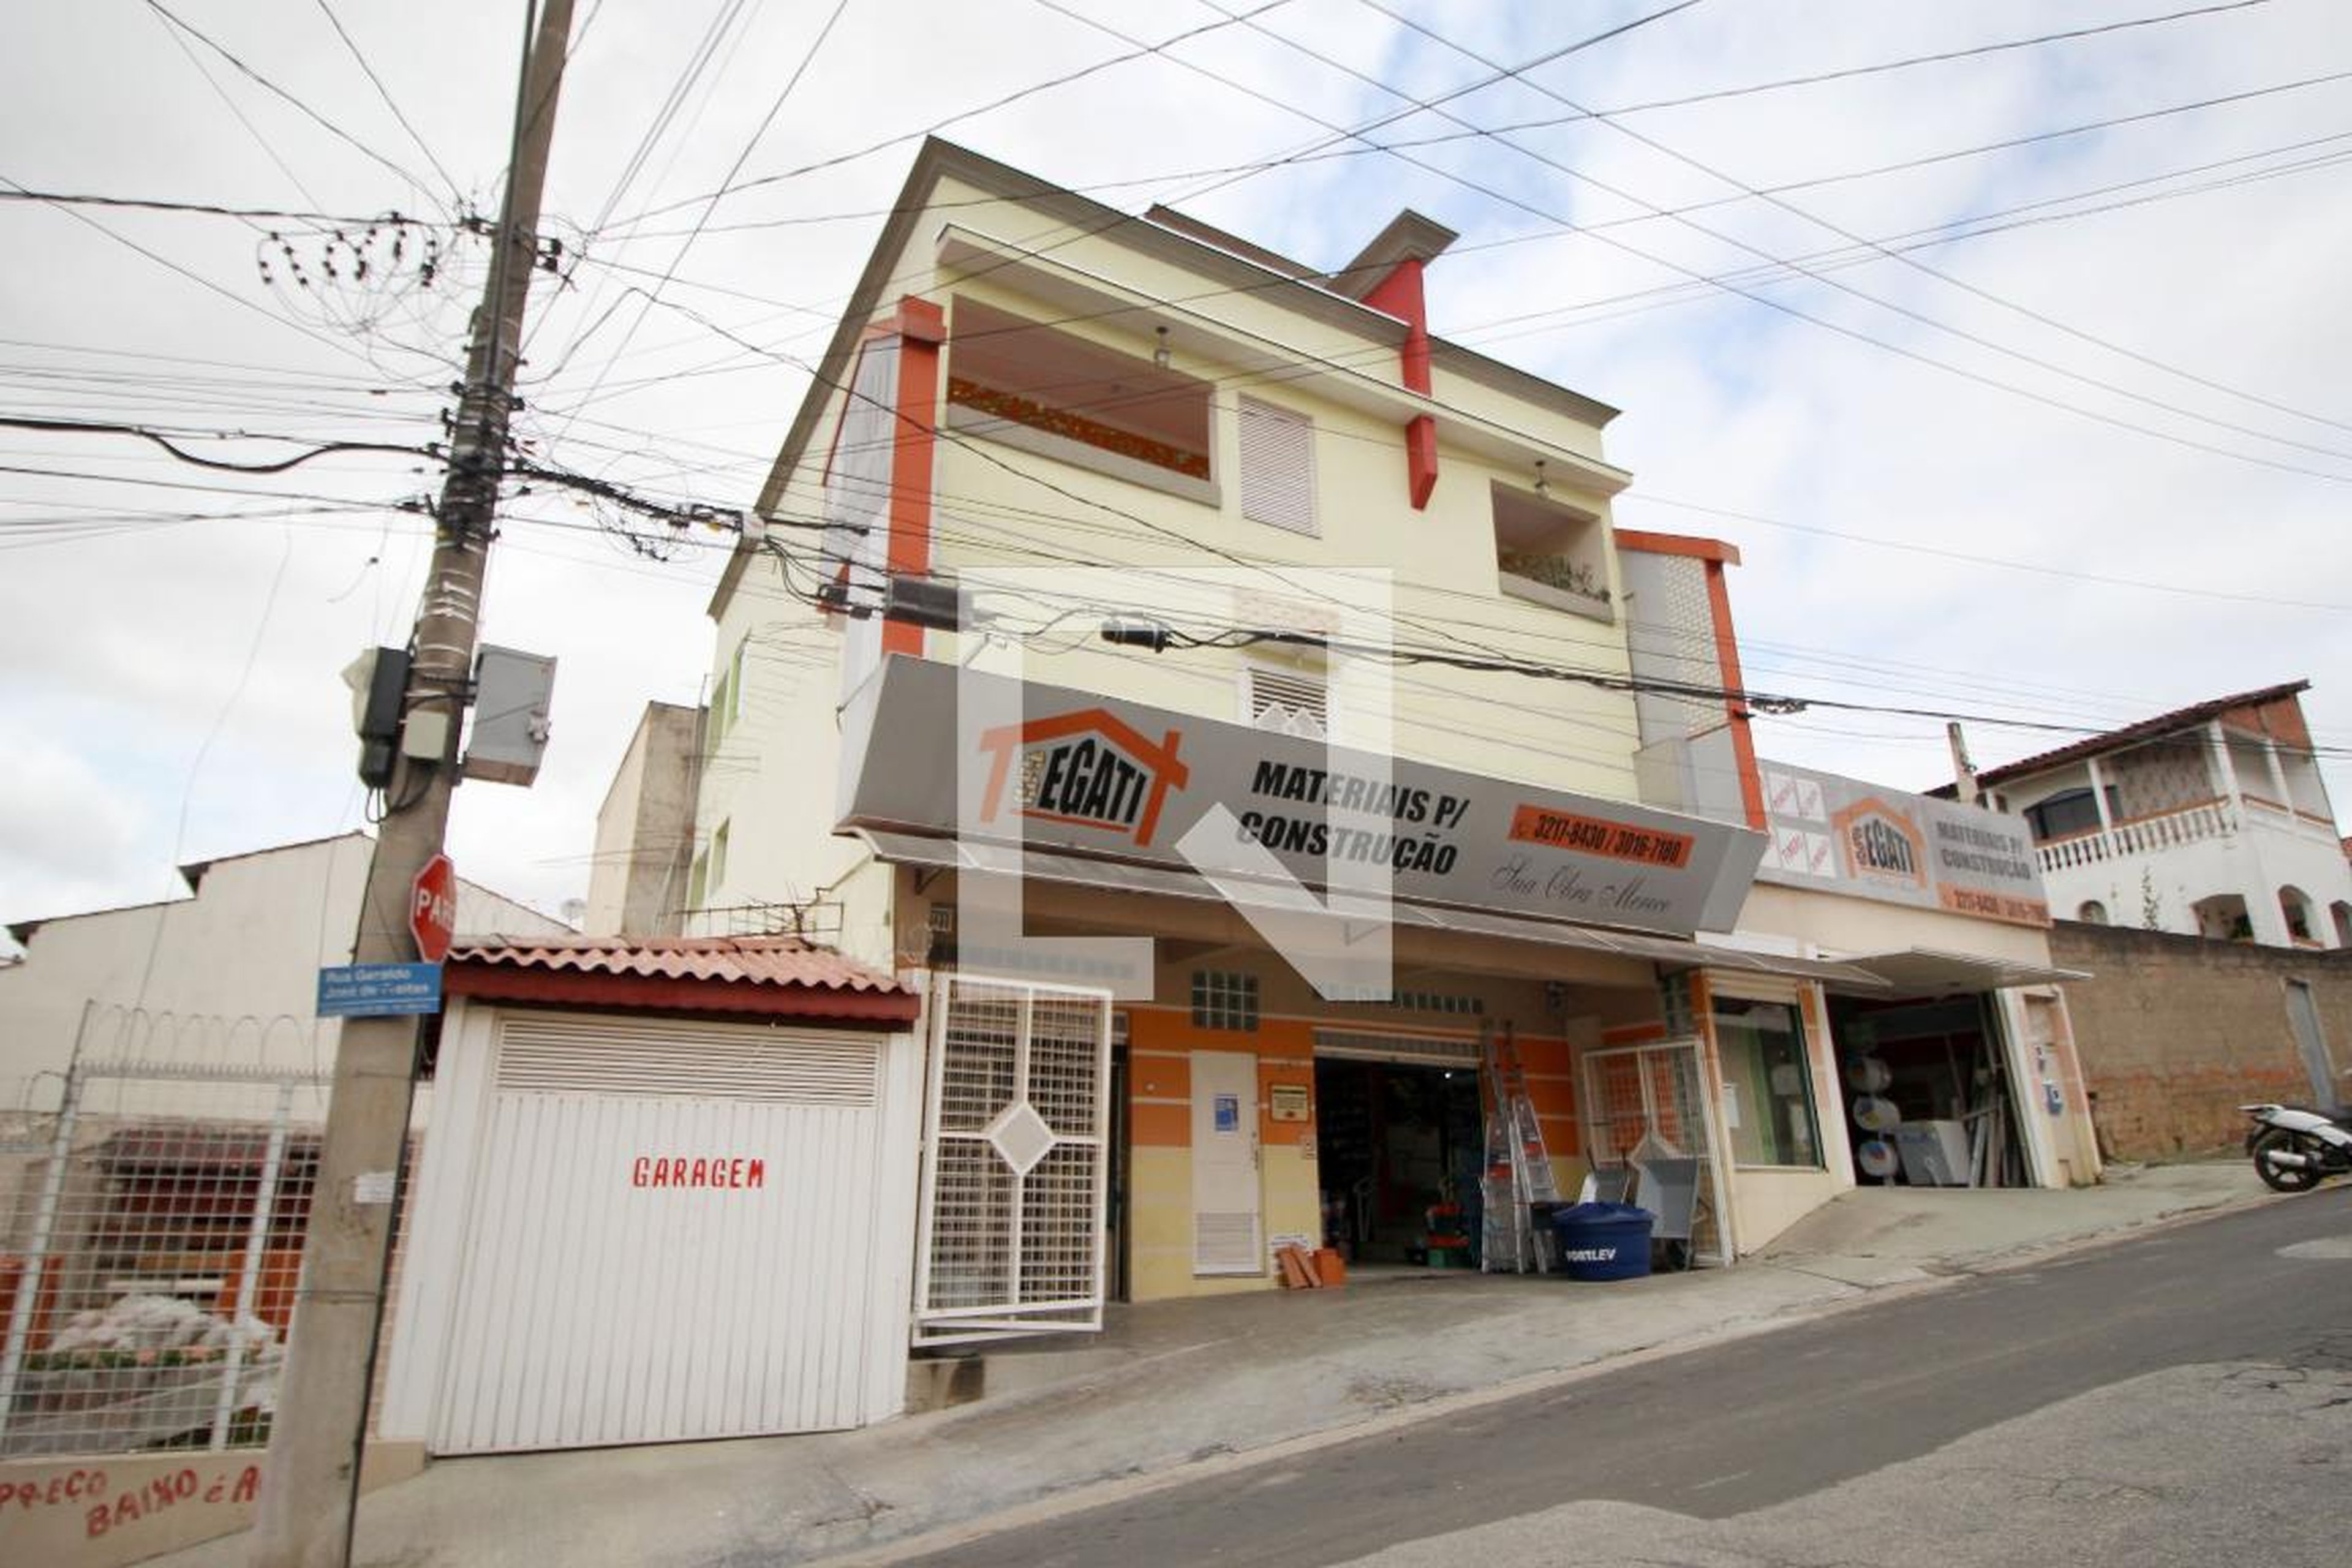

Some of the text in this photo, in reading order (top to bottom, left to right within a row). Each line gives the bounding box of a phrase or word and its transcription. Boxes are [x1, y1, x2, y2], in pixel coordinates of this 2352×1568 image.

[1251, 760, 1471, 831] MATERIAIS P/
[1235, 810, 1458, 876] CONSTRUÇÃO
[633, 1156, 764, 1188] GARAGEM
[85, 1469, 198, 1539] BAIXO
